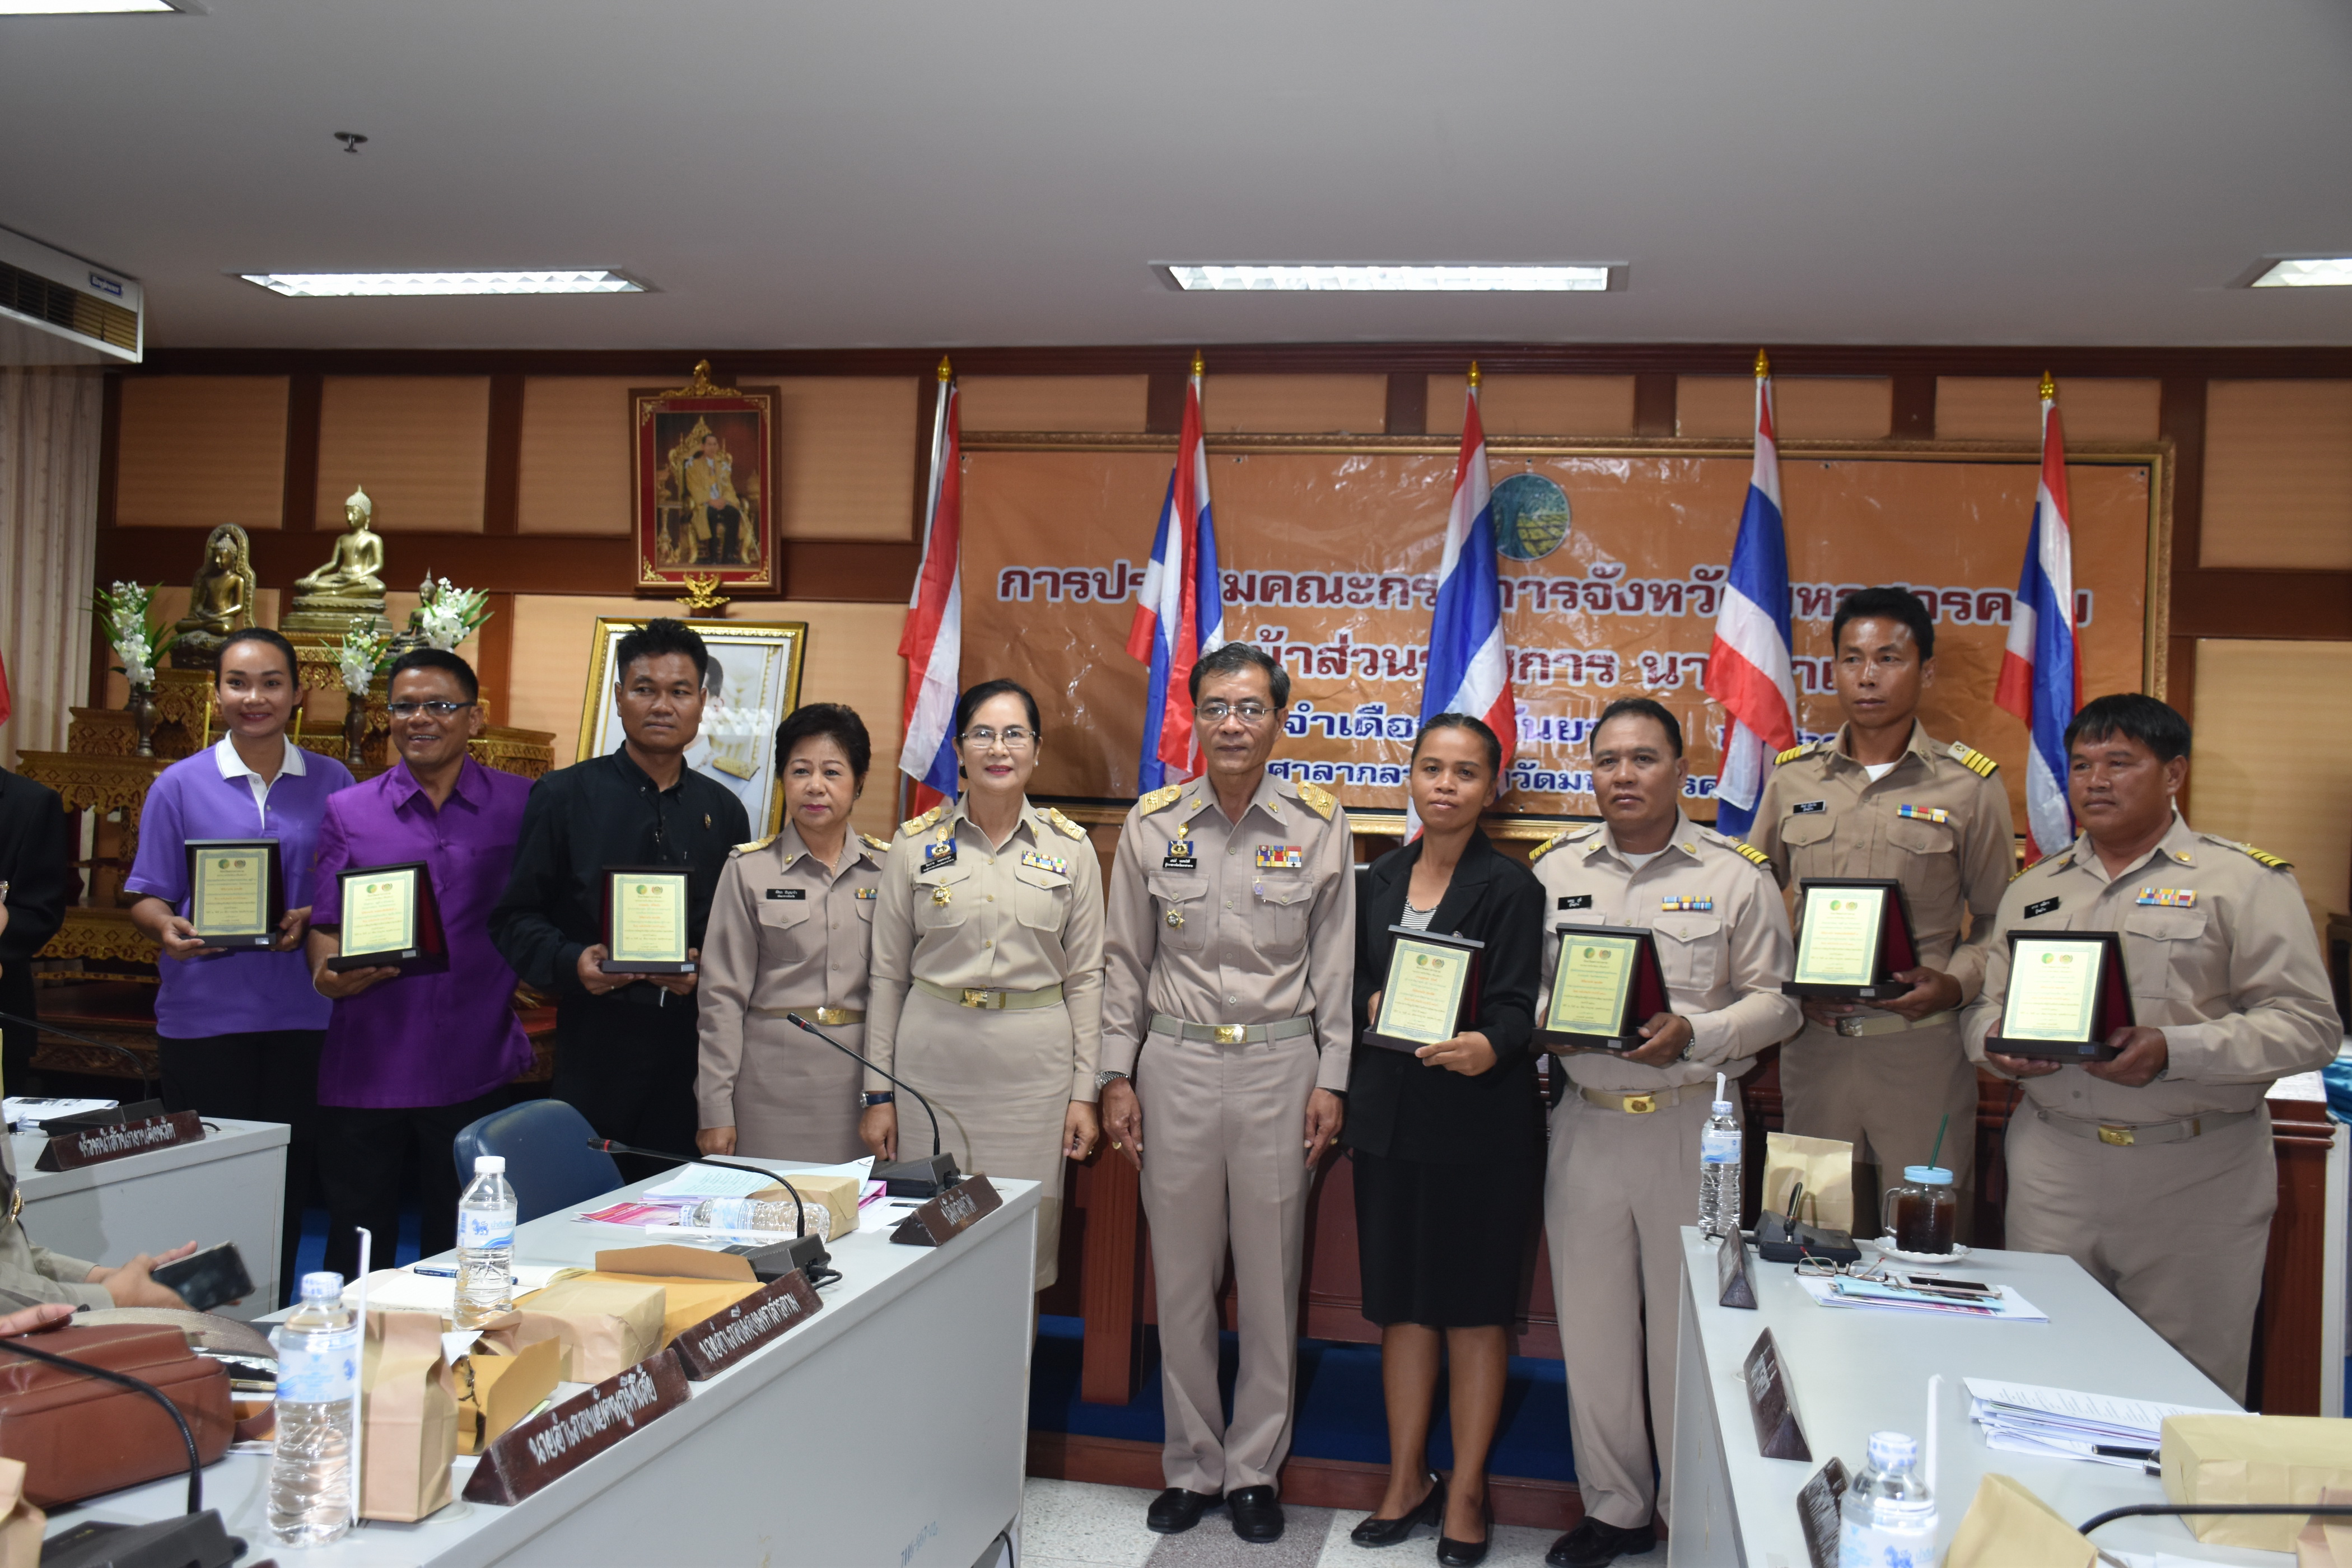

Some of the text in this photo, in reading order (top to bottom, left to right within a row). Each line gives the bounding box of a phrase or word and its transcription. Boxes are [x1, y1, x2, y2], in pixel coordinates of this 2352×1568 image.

[78, 1116, 176, 1158] หัวหน้าสำนักงานจังหวัด
[699, 1291, 801, 1364] นายอำเภอเมืองมหาสารคาม
[528, 1363, 658, 1466] นายอำเภอพยัคฆภูมิพิสัย
